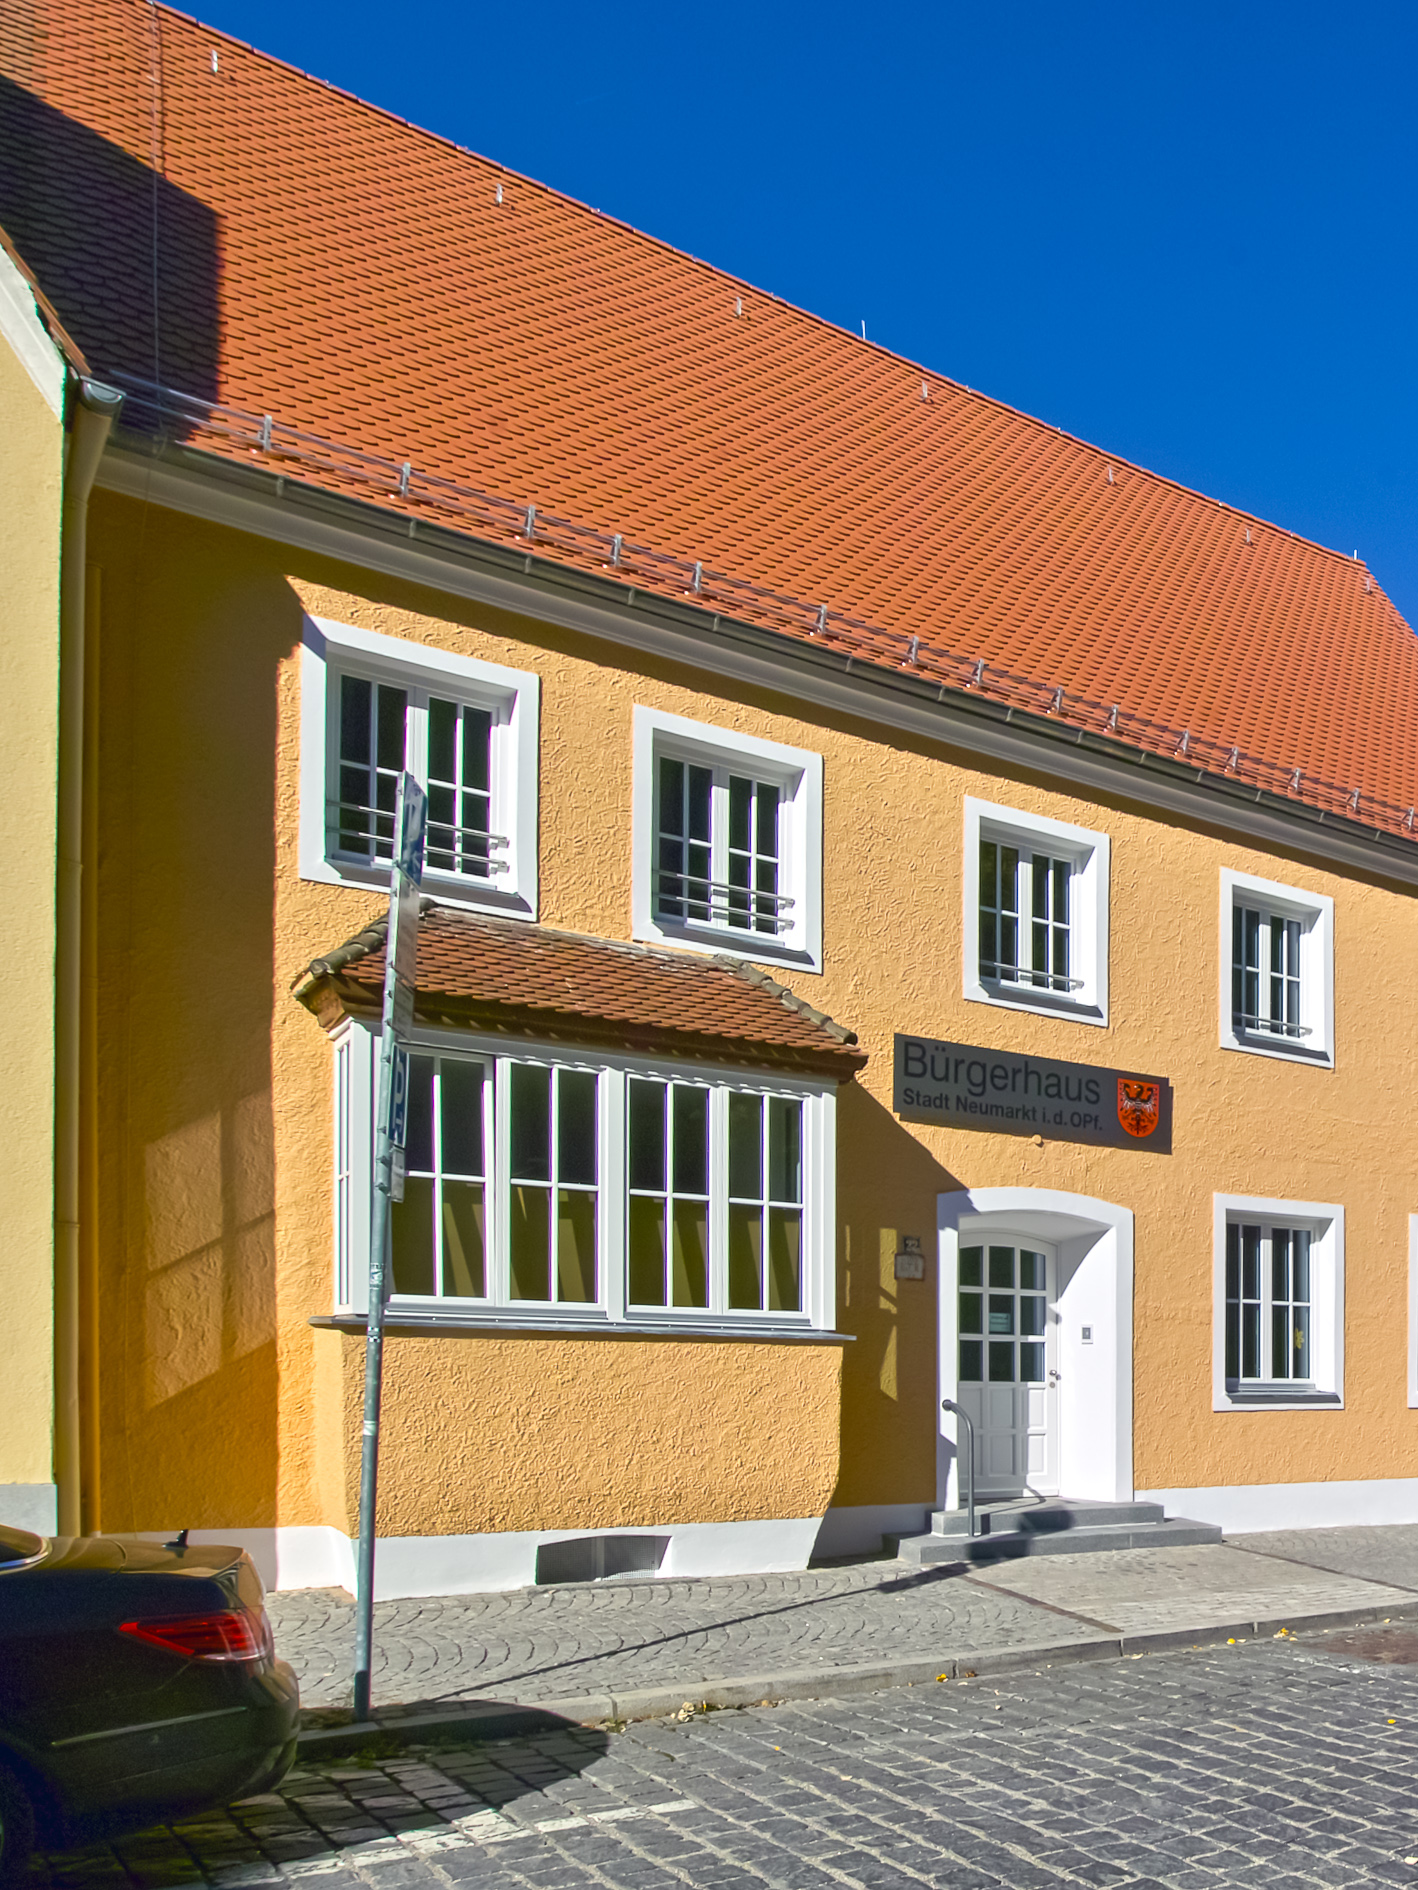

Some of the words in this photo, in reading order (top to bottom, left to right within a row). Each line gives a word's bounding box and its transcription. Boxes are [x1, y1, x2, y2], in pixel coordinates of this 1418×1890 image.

[903, 1041, 1101, 1105] Bürgerhaus
[903, 1087, 950, 1110] Stadt
[956, 1094, 1037, 1122] Neumarkt
